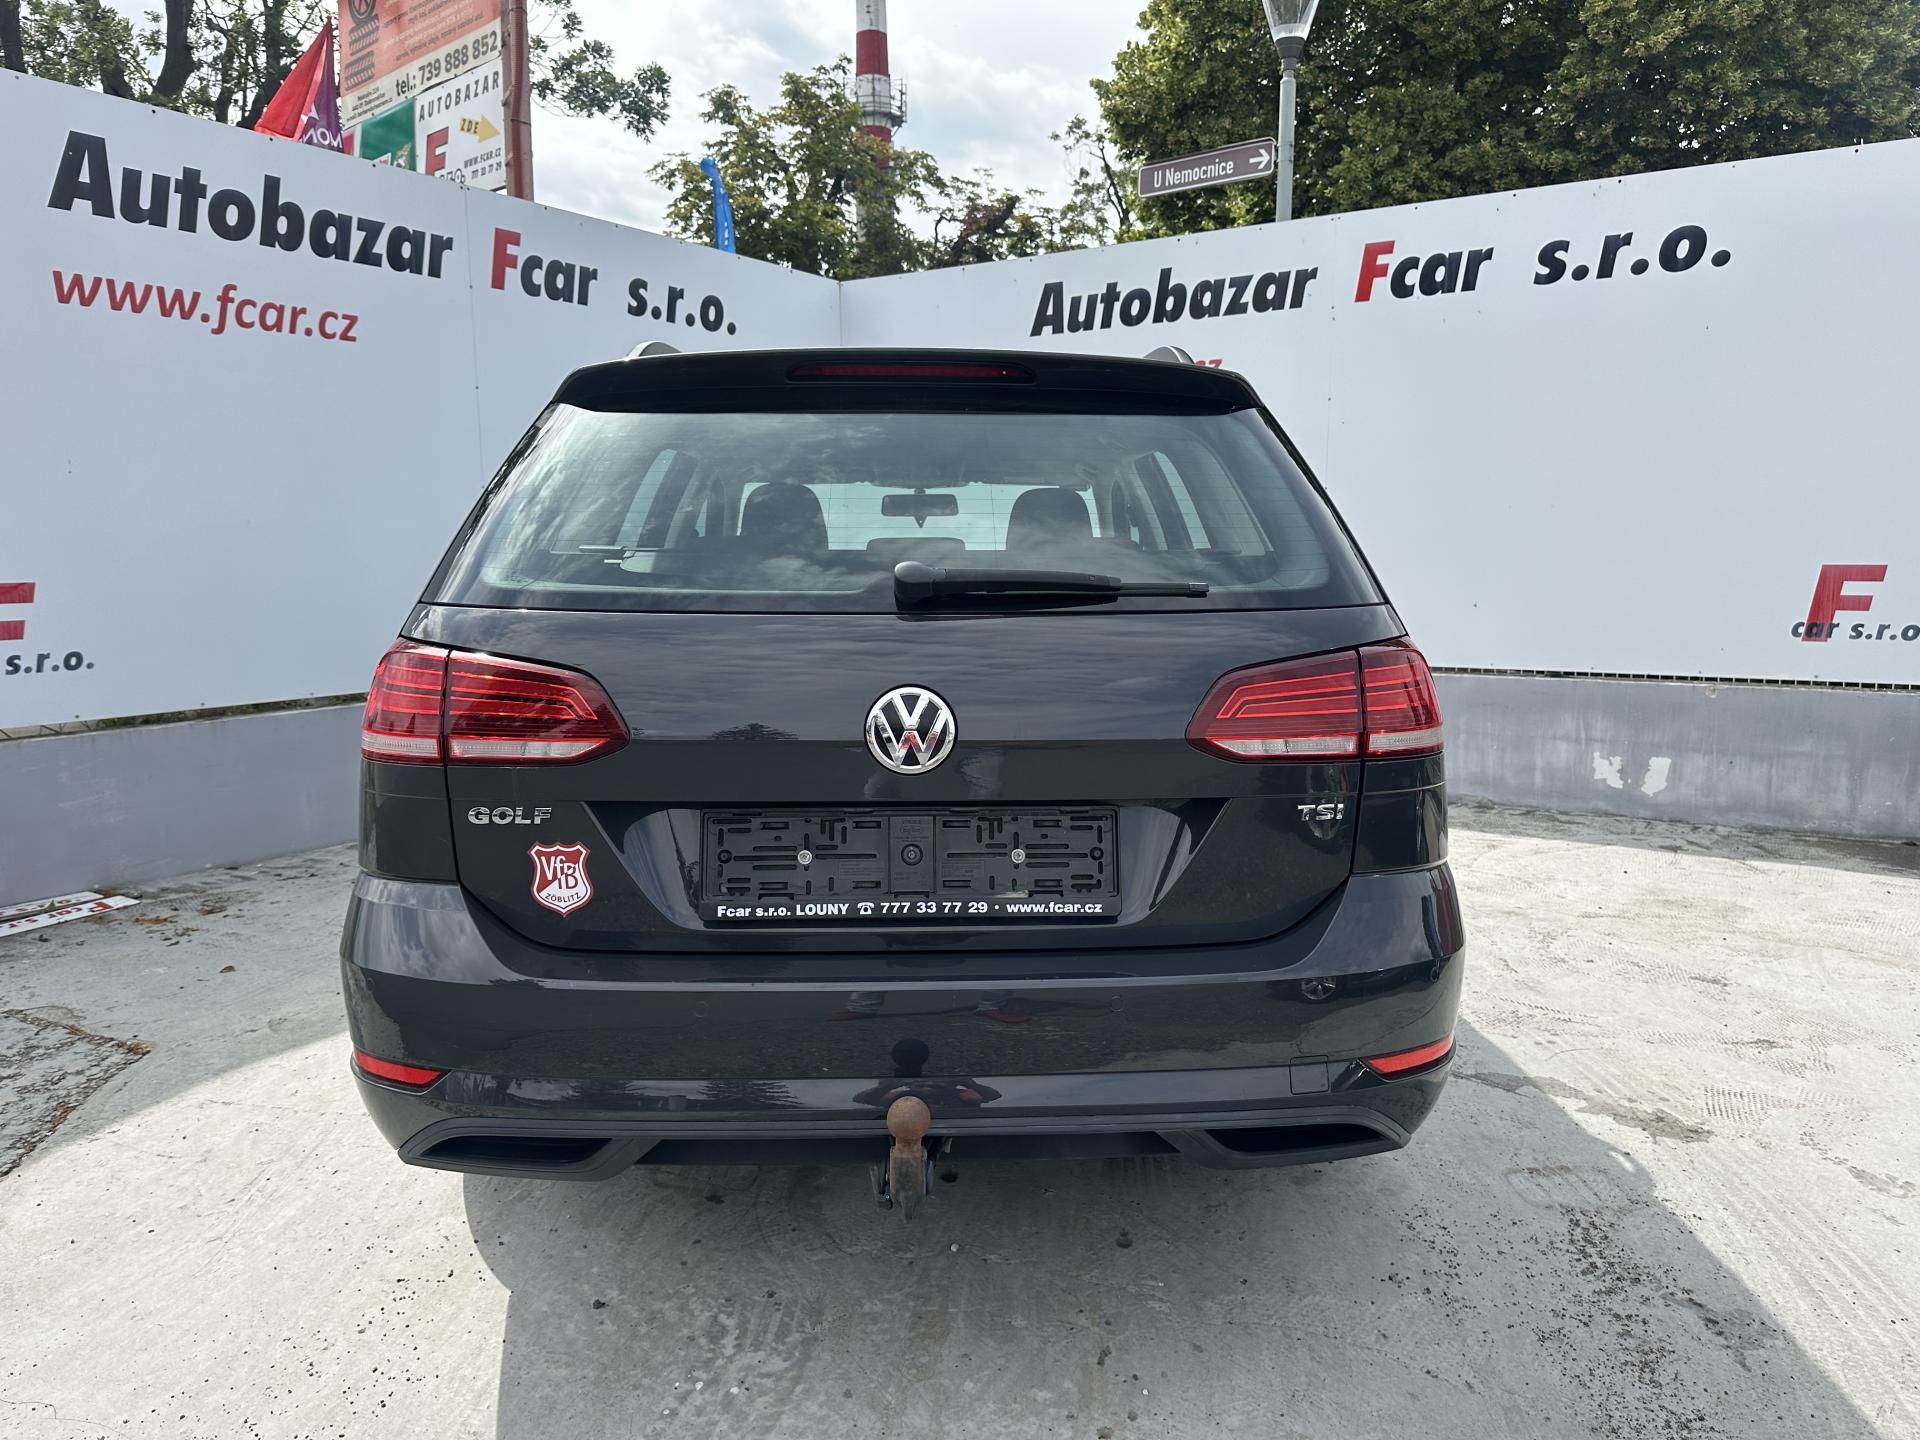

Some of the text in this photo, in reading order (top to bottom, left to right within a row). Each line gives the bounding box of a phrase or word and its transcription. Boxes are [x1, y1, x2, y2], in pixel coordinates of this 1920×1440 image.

[396, 73, 417, 97] tel.:
[418, 58, 441, 85] 739
[444, 44, 469, 73] 888
[472, 30, 498, 60] 852
[418, 70, 500, 122] AUTOBAZAR
[460, 117, 480, 135] ZDE
[1153, 158, 1235, 188] U Nemocnice
[47, 130, 738, 336] Autobazar Fcar s.r.o.
[1030, 224, 1732, 337] Autobazar Fcar s.r.o.
[52, 269, 360, 343] www.fcar.cz
[5, 650, 95, 675] s.r.o.
[467, 806, 552, 825] GOLF
[1297, 803, 1344, 821] TSI
[541, 855, 579, 890] VfB
[717, 901, 1103, 918] Fcar s.r.o. LOUNY 777 33 77 29 www.fcar.cz
